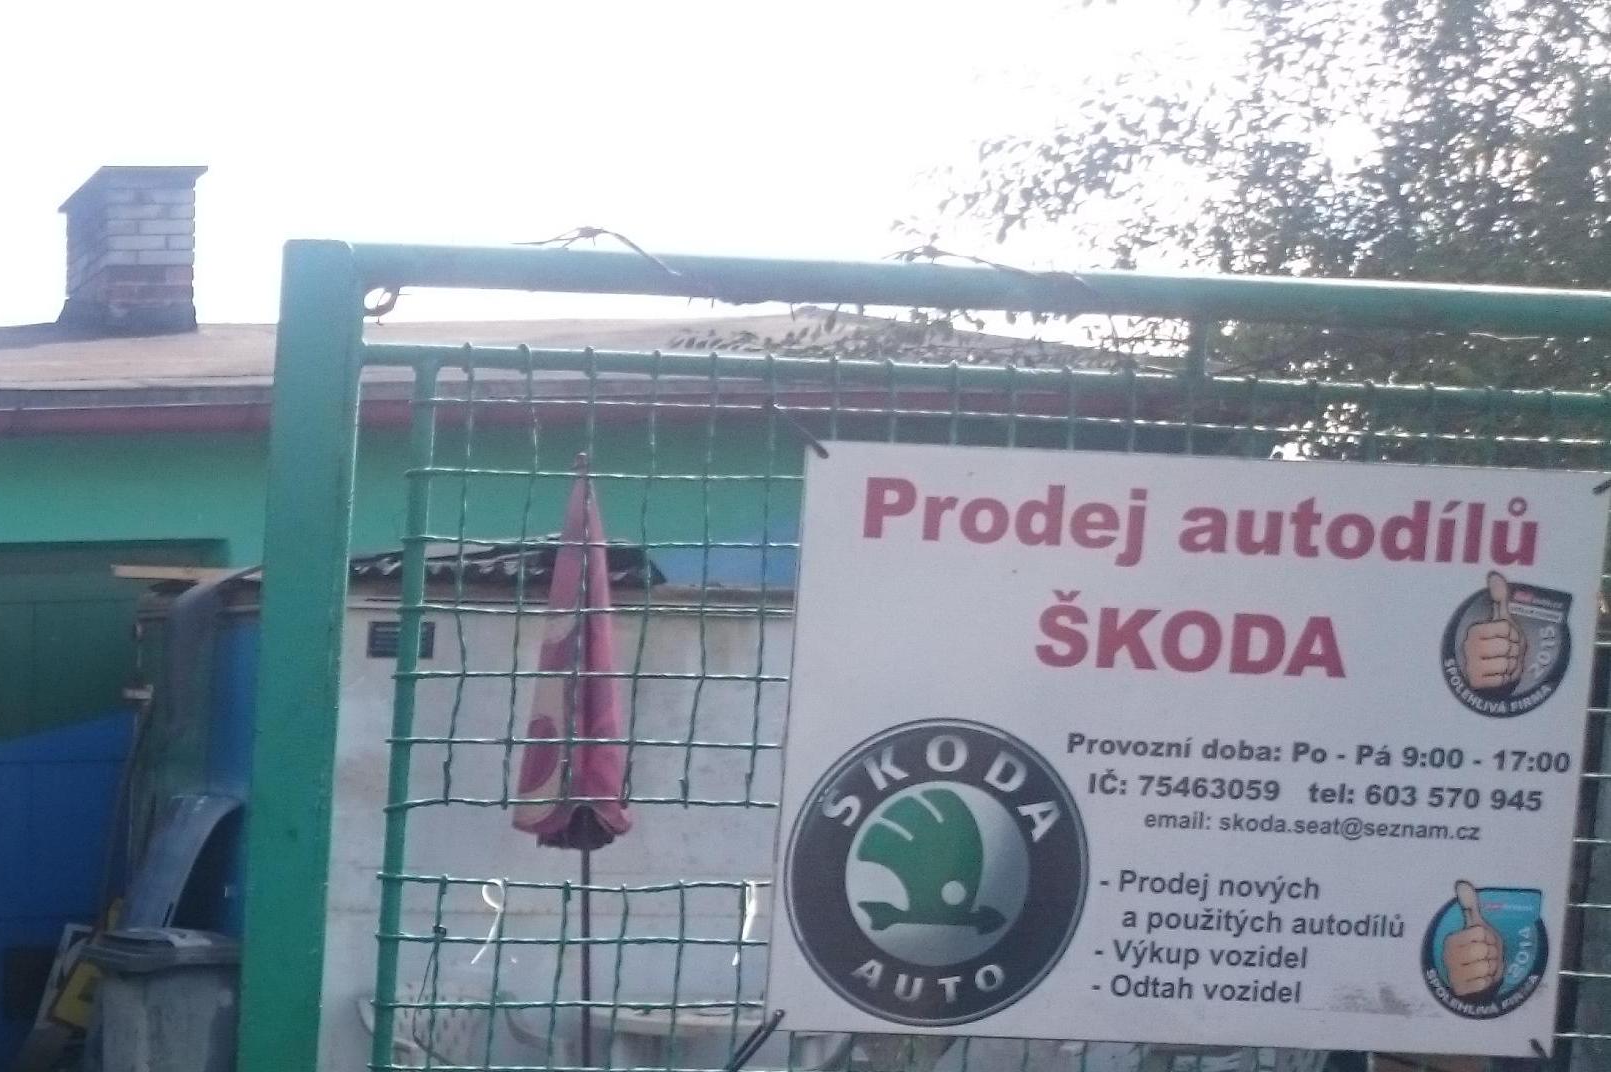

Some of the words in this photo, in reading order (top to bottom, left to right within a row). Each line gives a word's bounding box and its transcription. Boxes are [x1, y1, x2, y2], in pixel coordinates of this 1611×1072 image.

[862, 476, 1148, 568] Prodej
[1178, 496, 1539, 566] autodílů
[1035, 589, 1346, 678] ŠKODA
[1066, 731, 1192, 759] Provozní
[1201, 738, 1282, 762] doba:
[1291, 741, 1328, 764] Po
[1355, 744, 1391, 766] Pá
[1401, 745, 1464, 769] 9:00
[1493, 749, 1571, 773] 17:00
[1088, 768, 1127, 796] IČ:
[1138, 774, 1280, 801] 75463059
[1308, 782, 1355, 805] tel:
[1364, 783, 1418, 807] 603
[1427, 786, 1481, 810] 570
[1489, 788, 1543, 812] 945
[1143, 810, 1211, 831] email:
[1218, 812, 1481, 841] skoda.seat@seznam.cz
[1118, 869, 1210, 902] Prodej
[1218, 874, 1321, 904] nových
[1121, 910, 1137, 928] a
[1146, 906, 1283, 938] použitých
[1291, 912, 1406, 938] autodílů
[1112, 938, 1200, 970] Výkup
[1209, 946, 1308, 969] vozidel
[849, 958, 1005, 1004] AUTO
[1109, 974, 1194, 1000] Odtah
[1202, 979, 1302, 1004] vozidel
